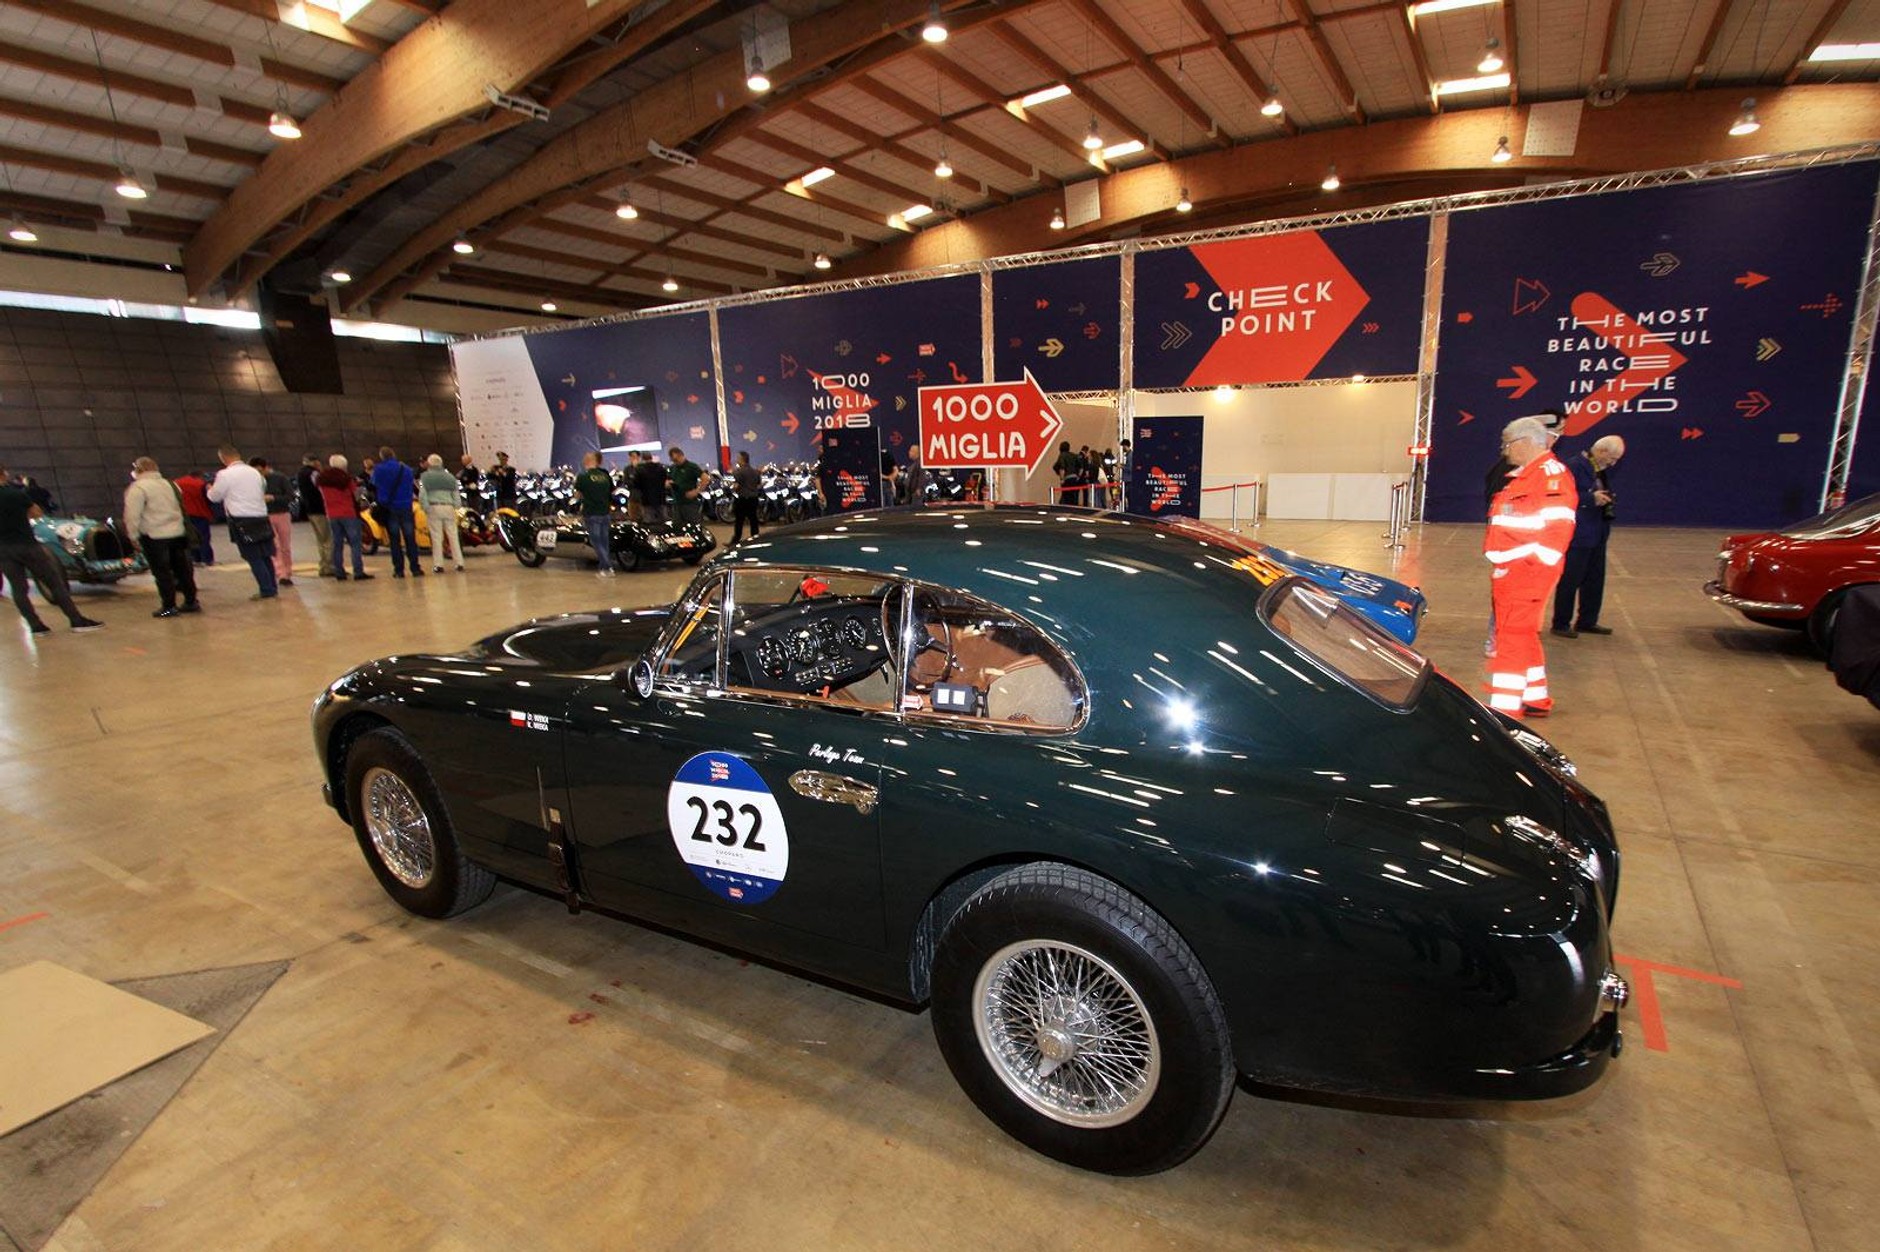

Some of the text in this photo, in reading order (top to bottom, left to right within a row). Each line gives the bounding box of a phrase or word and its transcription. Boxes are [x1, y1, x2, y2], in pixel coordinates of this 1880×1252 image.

[1208, 280, 1333, 312] CHECK
[1221, 310, 1316, 337] POINT
[1557, 307, 1709, 331] THE MOST
[1547, 330, 1712, 353] BEAUTIFUL
[1579, 354, 1671, 372] RACE
[812, 373, 870, 391] 1000
[1569, 376, 1677, 394] IN THE
[811, 393, 872, 411] MIGLIA
[932, 392, 1019, 423] 1000
[1563, 398, 1679, 415] WORLD
[814, 413, 871, 430] 2018
[928, 431, 1026, 460] MIGLIA
[686, 795, 767, 852] 232
